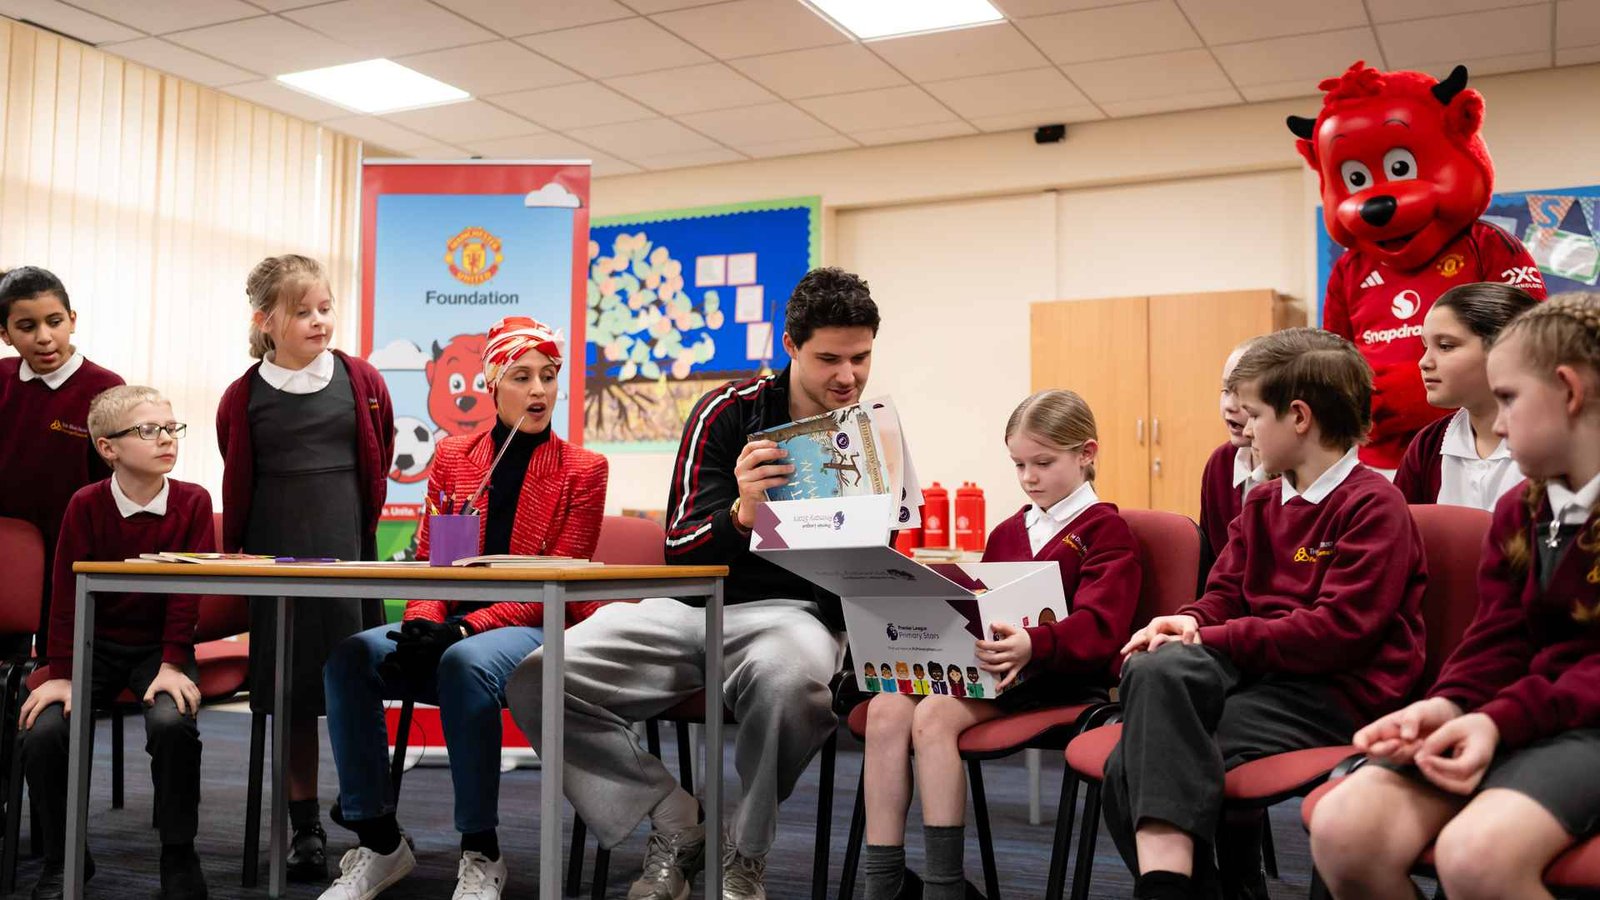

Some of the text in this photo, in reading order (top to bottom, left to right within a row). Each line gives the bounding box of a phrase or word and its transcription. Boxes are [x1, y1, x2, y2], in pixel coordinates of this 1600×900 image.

[1537, 199, 1561, 228] S
[457, 270, 492, 285] UNITED
[425, 290, 519, 305] Foundation
[1362, 323, 1423, 345] Snapdra
[899, 631, 940, 641] Primary Stars
